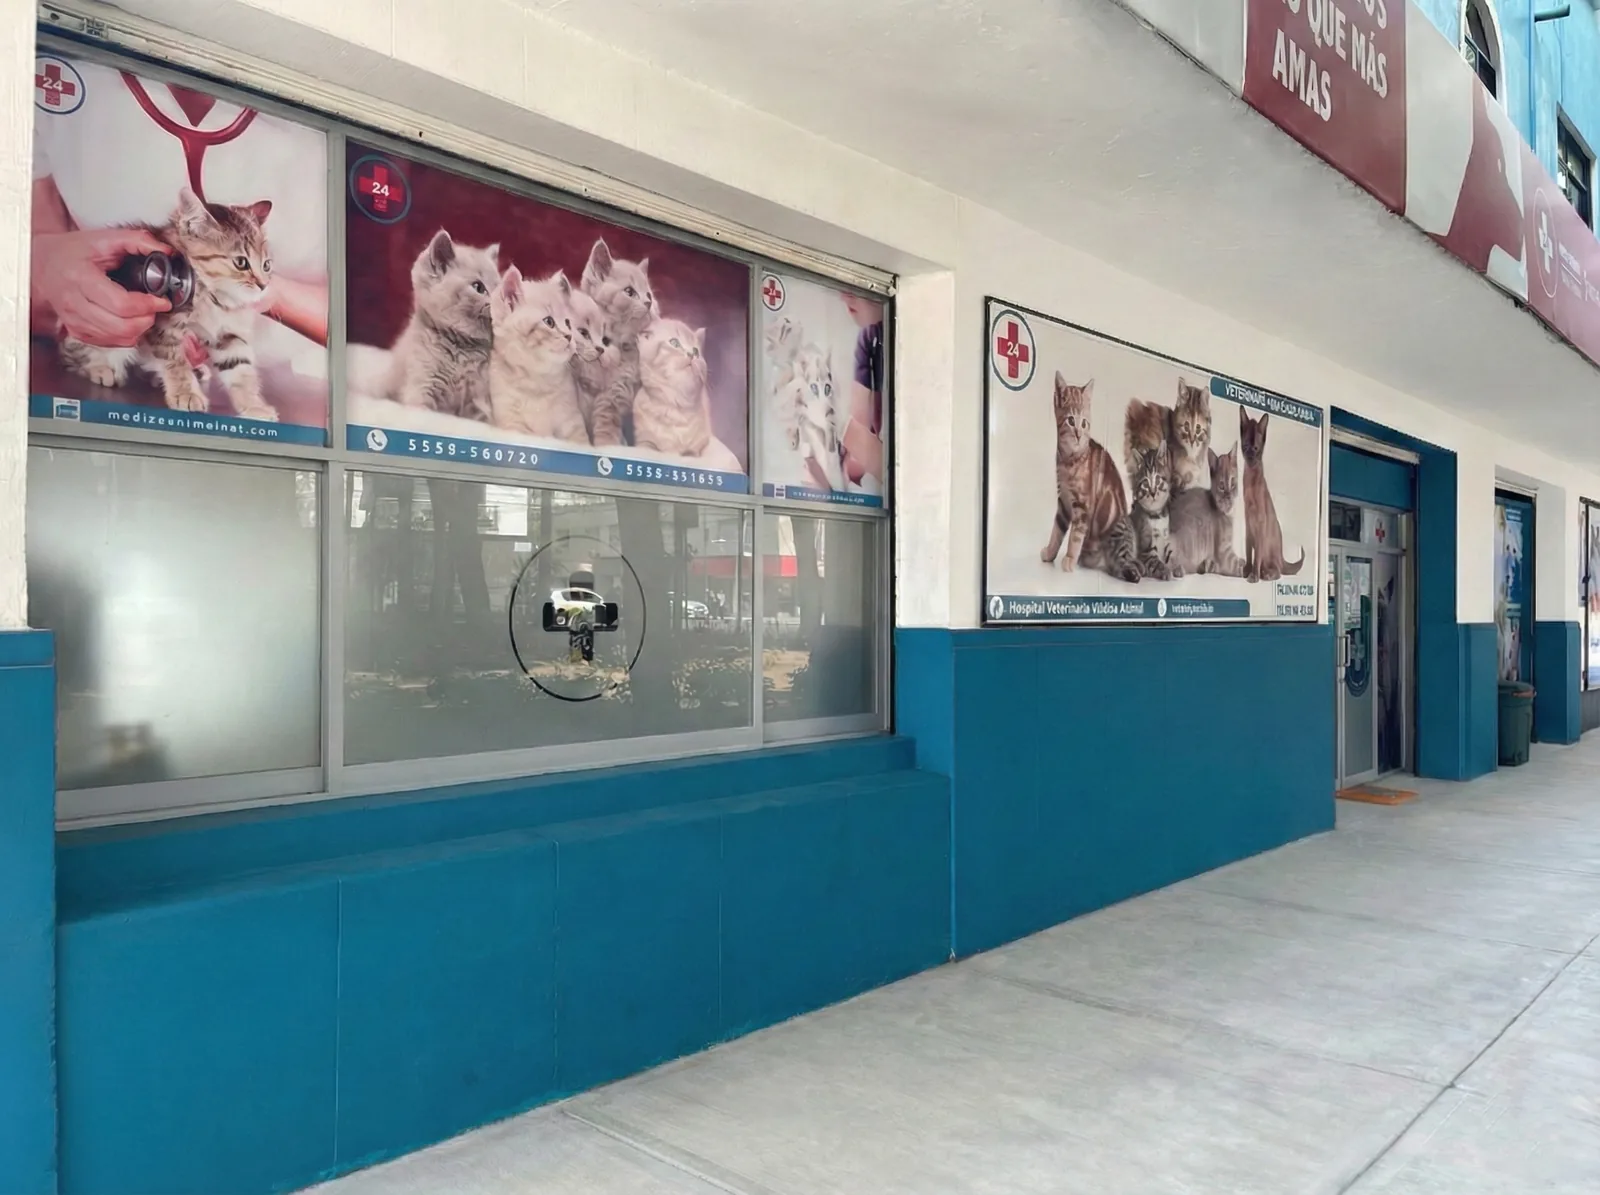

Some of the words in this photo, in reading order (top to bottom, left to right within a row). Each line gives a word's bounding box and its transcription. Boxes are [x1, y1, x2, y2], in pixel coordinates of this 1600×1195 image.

[1307, 0, 1346, 61] QUE
[1351, 23, 1387, 98] MÁS
[1272, 28, 1332, 121] AMAS
[42, 77, 63, 91] 24
[372, 182, 389, 196] 24
[1007, 341, 1019, 358] 24
[1009, 601, 1045, 617] Hospital
